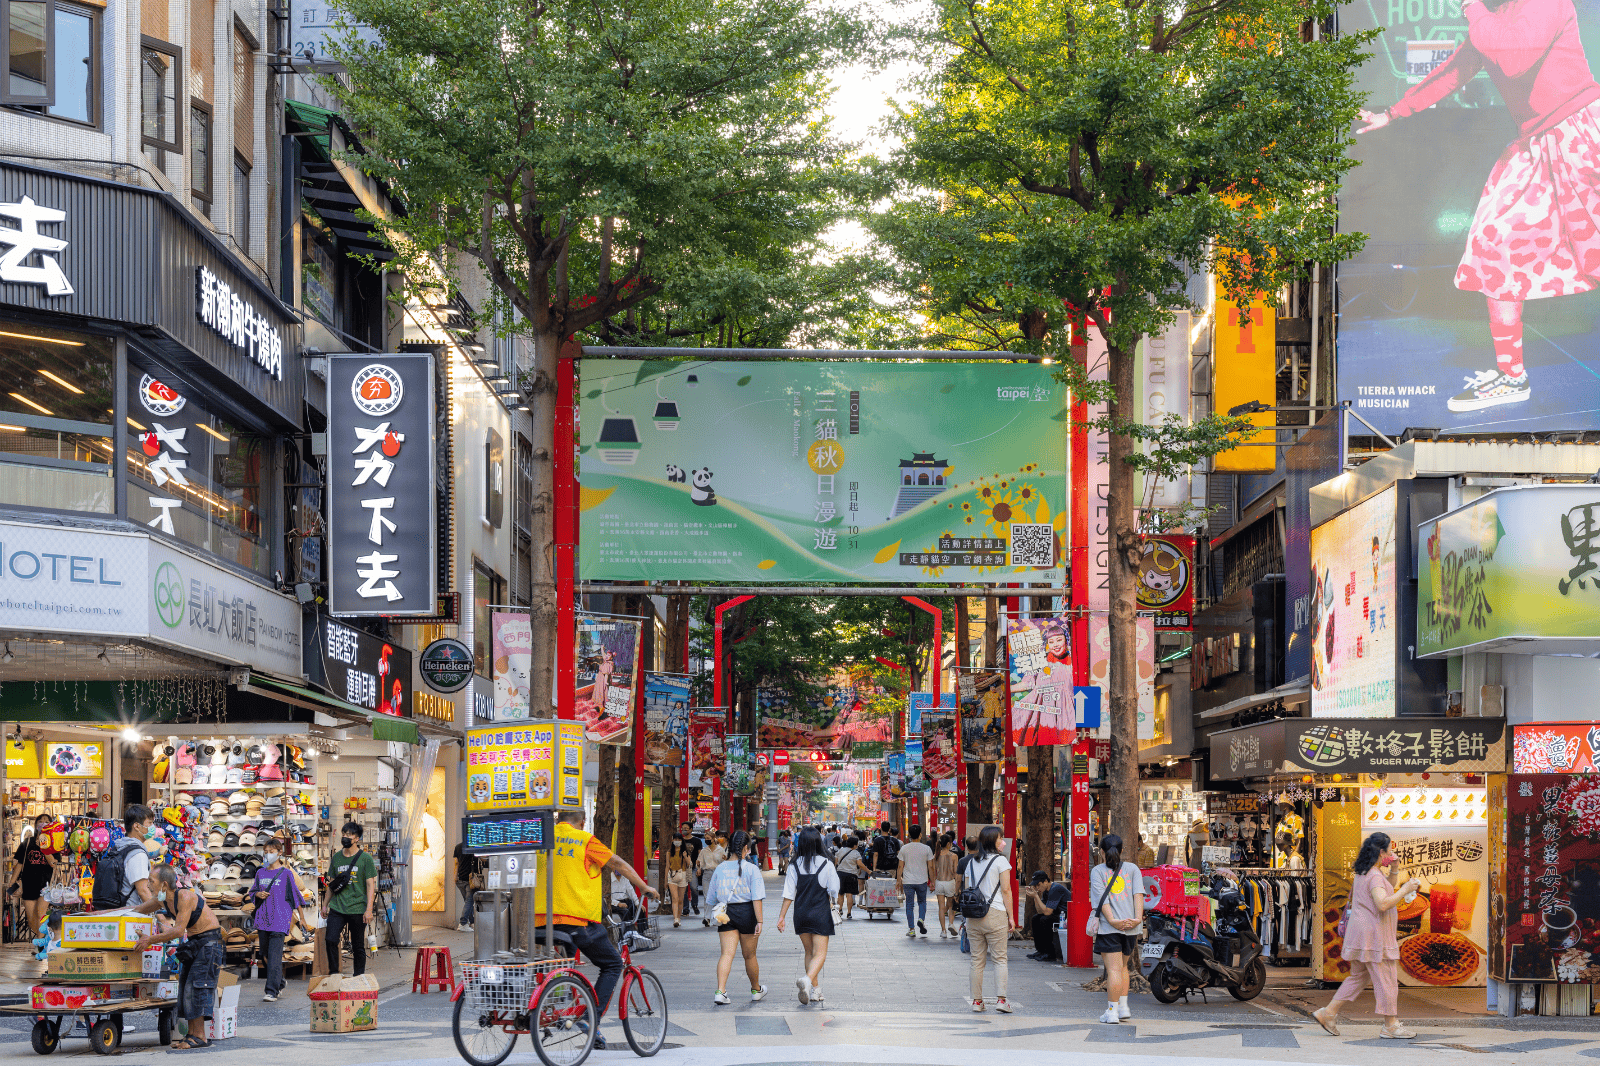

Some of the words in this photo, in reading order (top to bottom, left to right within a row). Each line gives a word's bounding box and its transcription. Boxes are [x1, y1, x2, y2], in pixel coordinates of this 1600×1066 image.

[997, 387, 1030, 401] taipei
[1358, 386, 1396, 396] TIERRA
[1398, 385, 1436, 396] WHACK
[1358, 399, 1410, 408] MUSICIAN
[813, 391, 838, 550] 三貓秋日漫遊
[941, 539, 1004, 549] 活動詳情請上
[0, 542, 122, 587] OTEL
[188, 578, 257, 647] 長虹大飯店
[327, 620, 358, 666] 智能藍牙
[424, 661, 471, 671] Heineken
[533, 730, 552, 744] App
[1345, 728, 1485, 759] 數格子鬆餅
[1075, 782, 1089, 793] 15
[1006, 793, 1016, 801] 17
[510, 859, 515, 871] 3
[1407, 862, 1453, 879] WAFFLE
